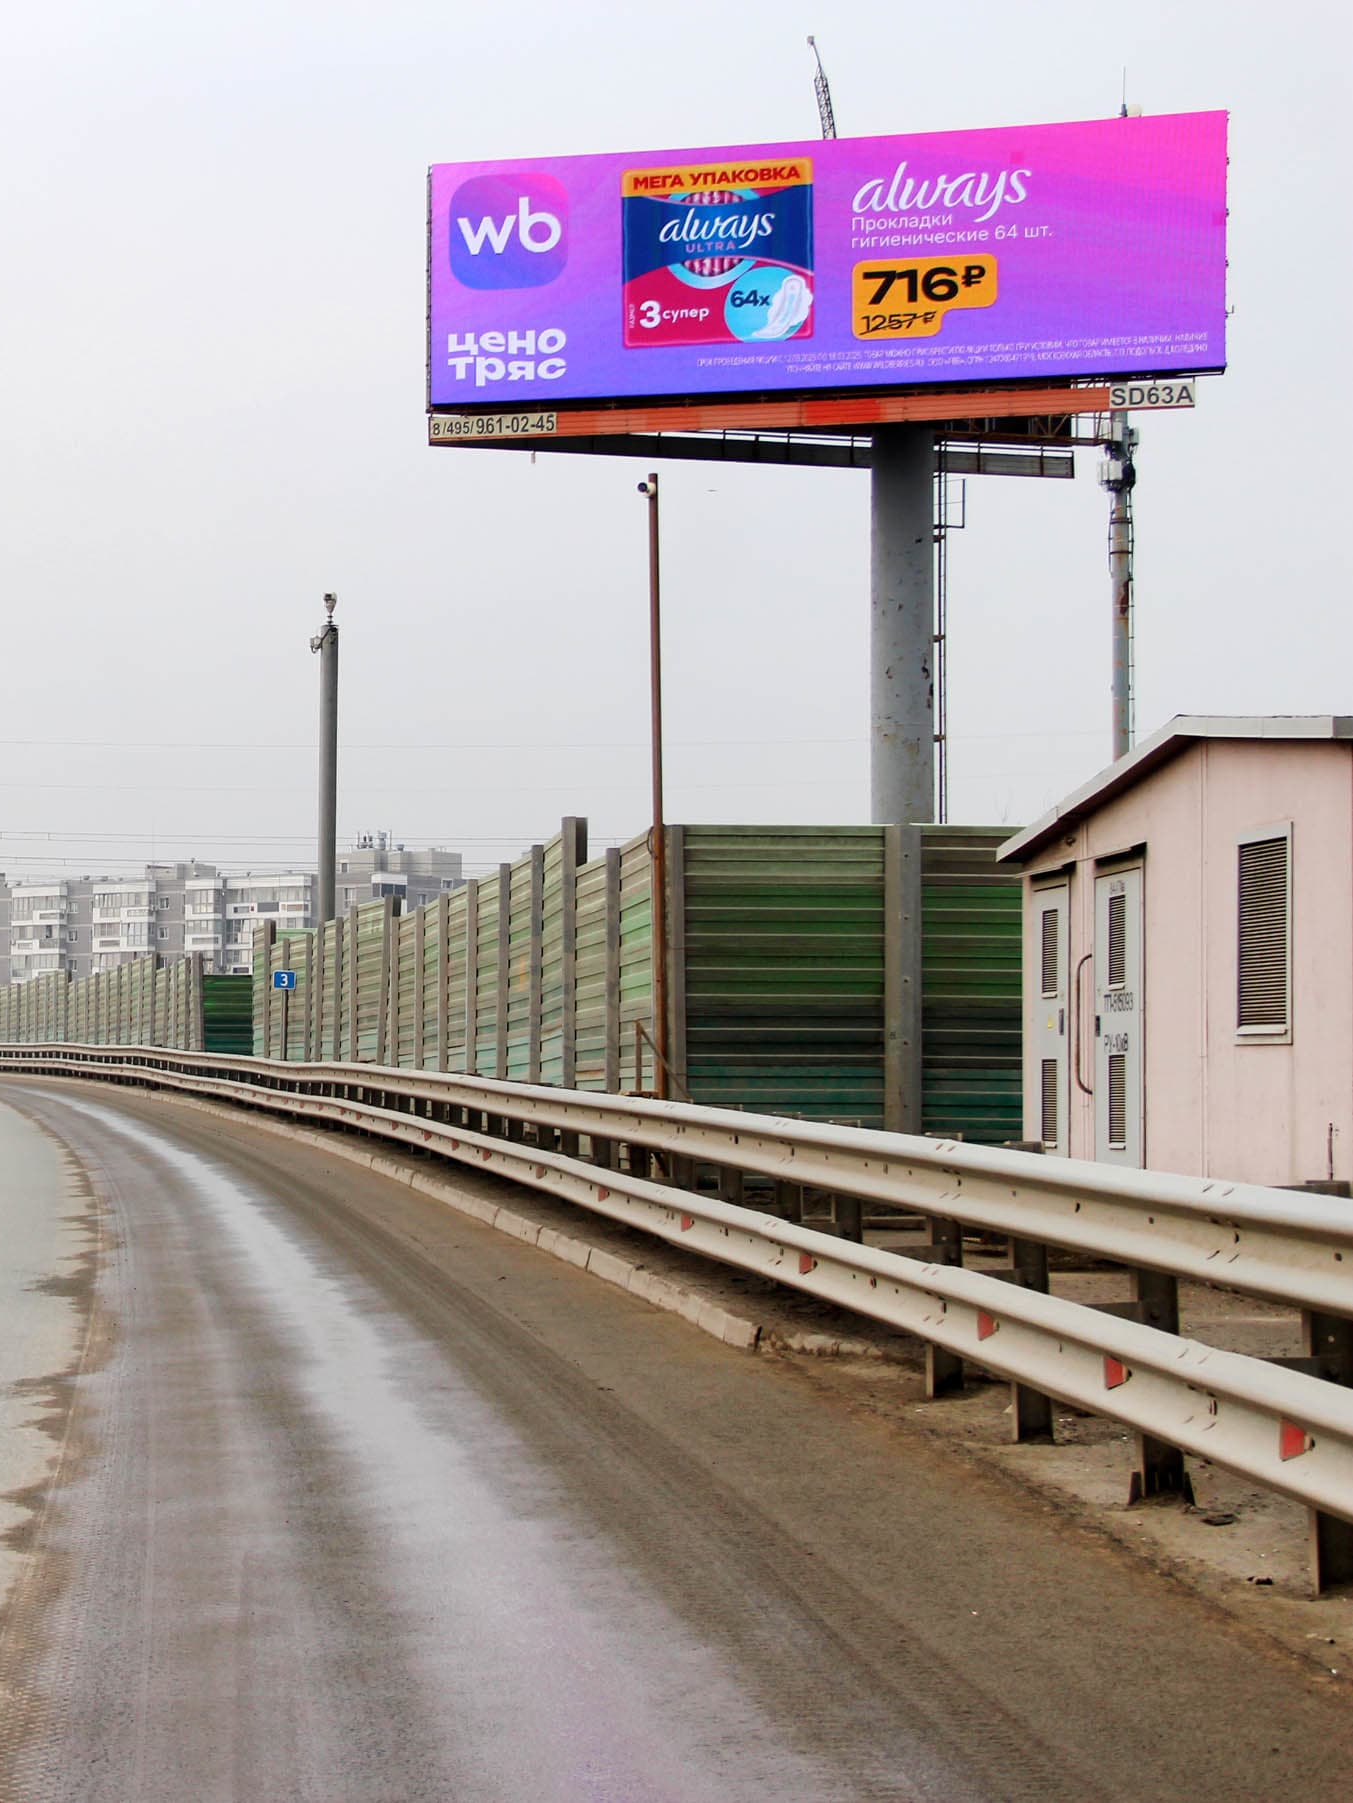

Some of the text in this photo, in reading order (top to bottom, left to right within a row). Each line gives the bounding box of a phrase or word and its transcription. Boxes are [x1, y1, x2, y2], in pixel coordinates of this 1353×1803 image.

[633, 166, 801, 190] МЕГА УПАКОВКА
[852, 161, 1032, 223] always
[457, 197, 562, 255] wb
[659, 208, 775, 249] always
[851, 214, 952, 234] Прокладки
[851, 224, 1054, 249] гигиенические 64 шт.
[686, 241, 736, 253] ULTRA
[639, 300, 709, 328] 3 супер
[448, 328, 567, 355] цено
[448, 356, 568, 387] тряс
[1111, 386, 1194, 406] SD63A
[280, 973, 288, 987] 3
